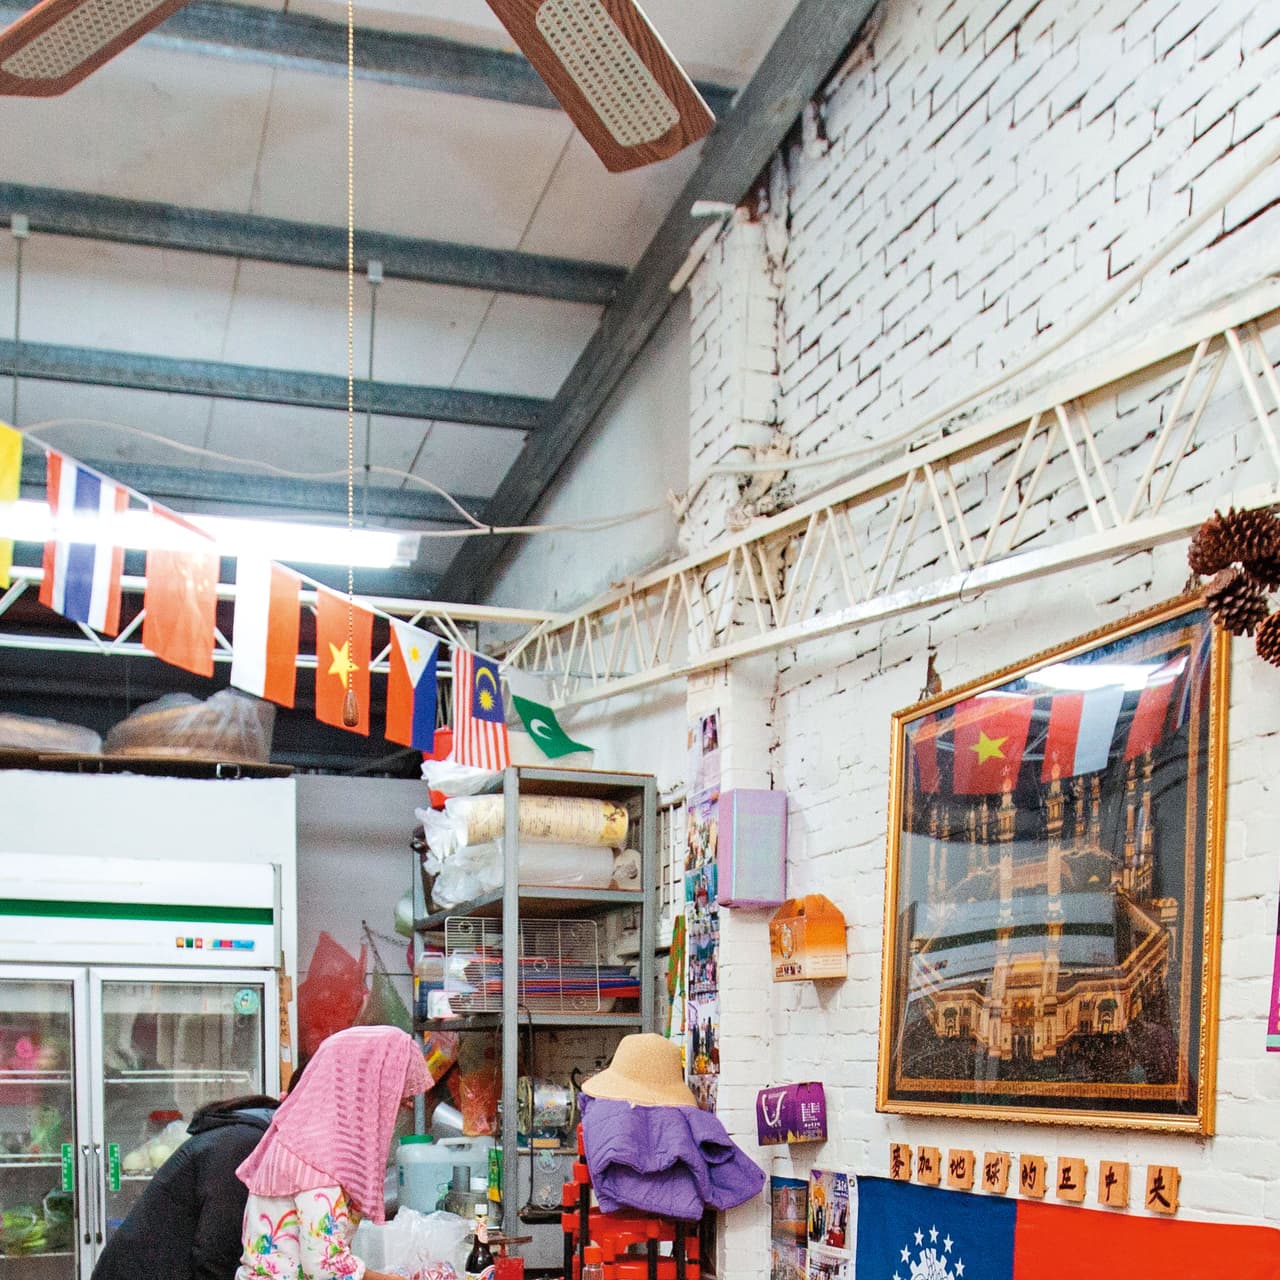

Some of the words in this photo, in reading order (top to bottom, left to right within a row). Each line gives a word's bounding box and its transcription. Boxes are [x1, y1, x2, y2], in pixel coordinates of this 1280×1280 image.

[891, 1143, 1173, 1209] 麥加地球的正中央
